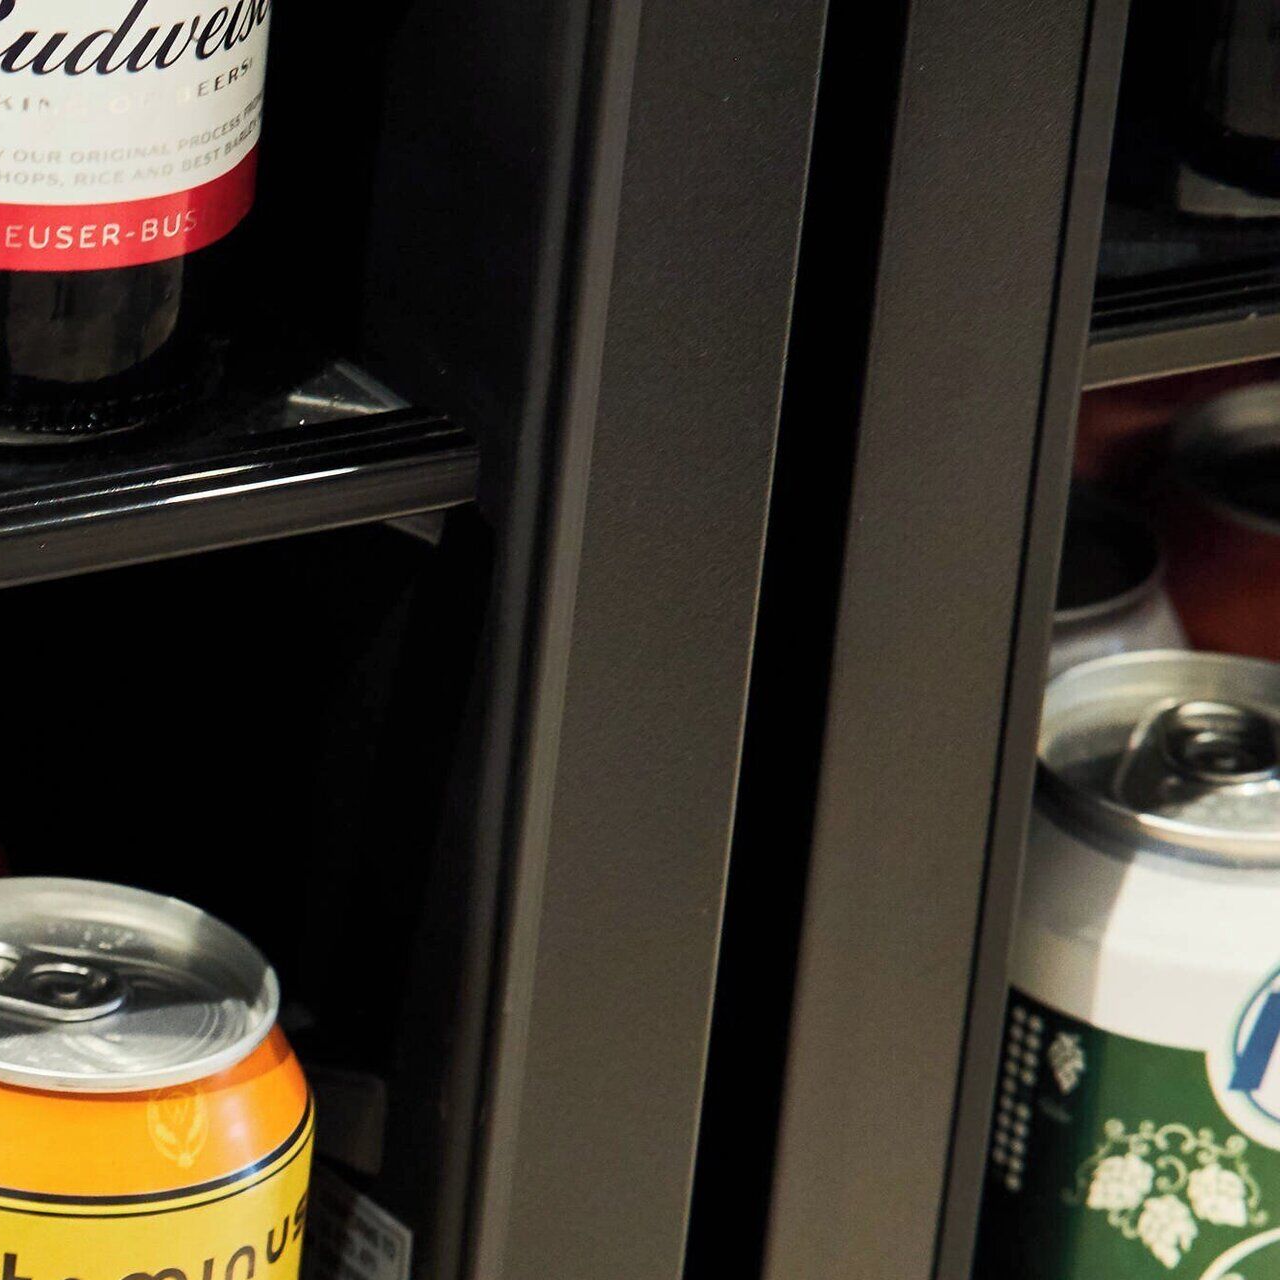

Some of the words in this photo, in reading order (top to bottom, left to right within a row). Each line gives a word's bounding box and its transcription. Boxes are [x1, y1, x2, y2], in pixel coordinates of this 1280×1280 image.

[12, 148, 63, 165] OUR
[70, 142, 171, 165] ORIGINAL
[177, 113, 242, 151] PROCESS
[73, 168, 125, 186] RICE
[132, 160, 175, 182] AND
[181, 145, 221, 171] BEST
